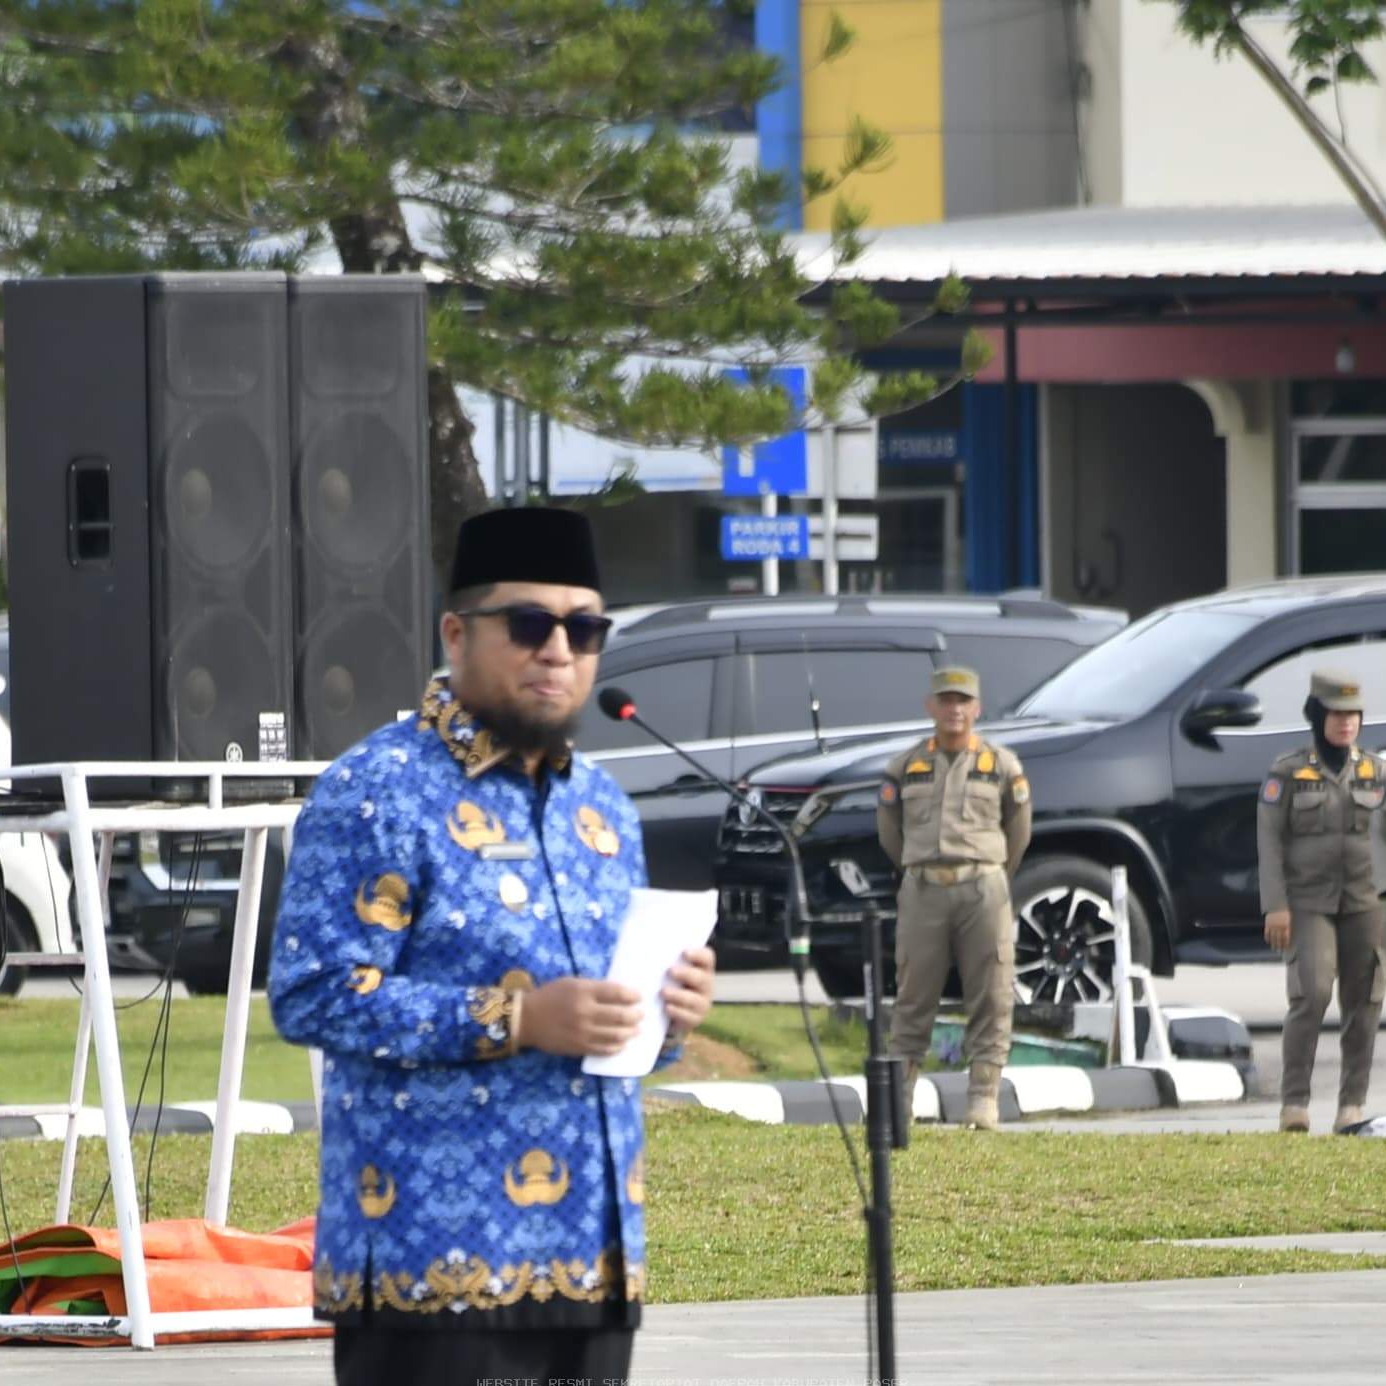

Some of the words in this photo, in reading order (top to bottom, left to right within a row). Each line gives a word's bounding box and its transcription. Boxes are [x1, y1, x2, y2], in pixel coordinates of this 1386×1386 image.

[729, 520, 800, 537] PARKIR
[730, 538, 784, 556] RODA
[787, 538, 800, 556] 4
